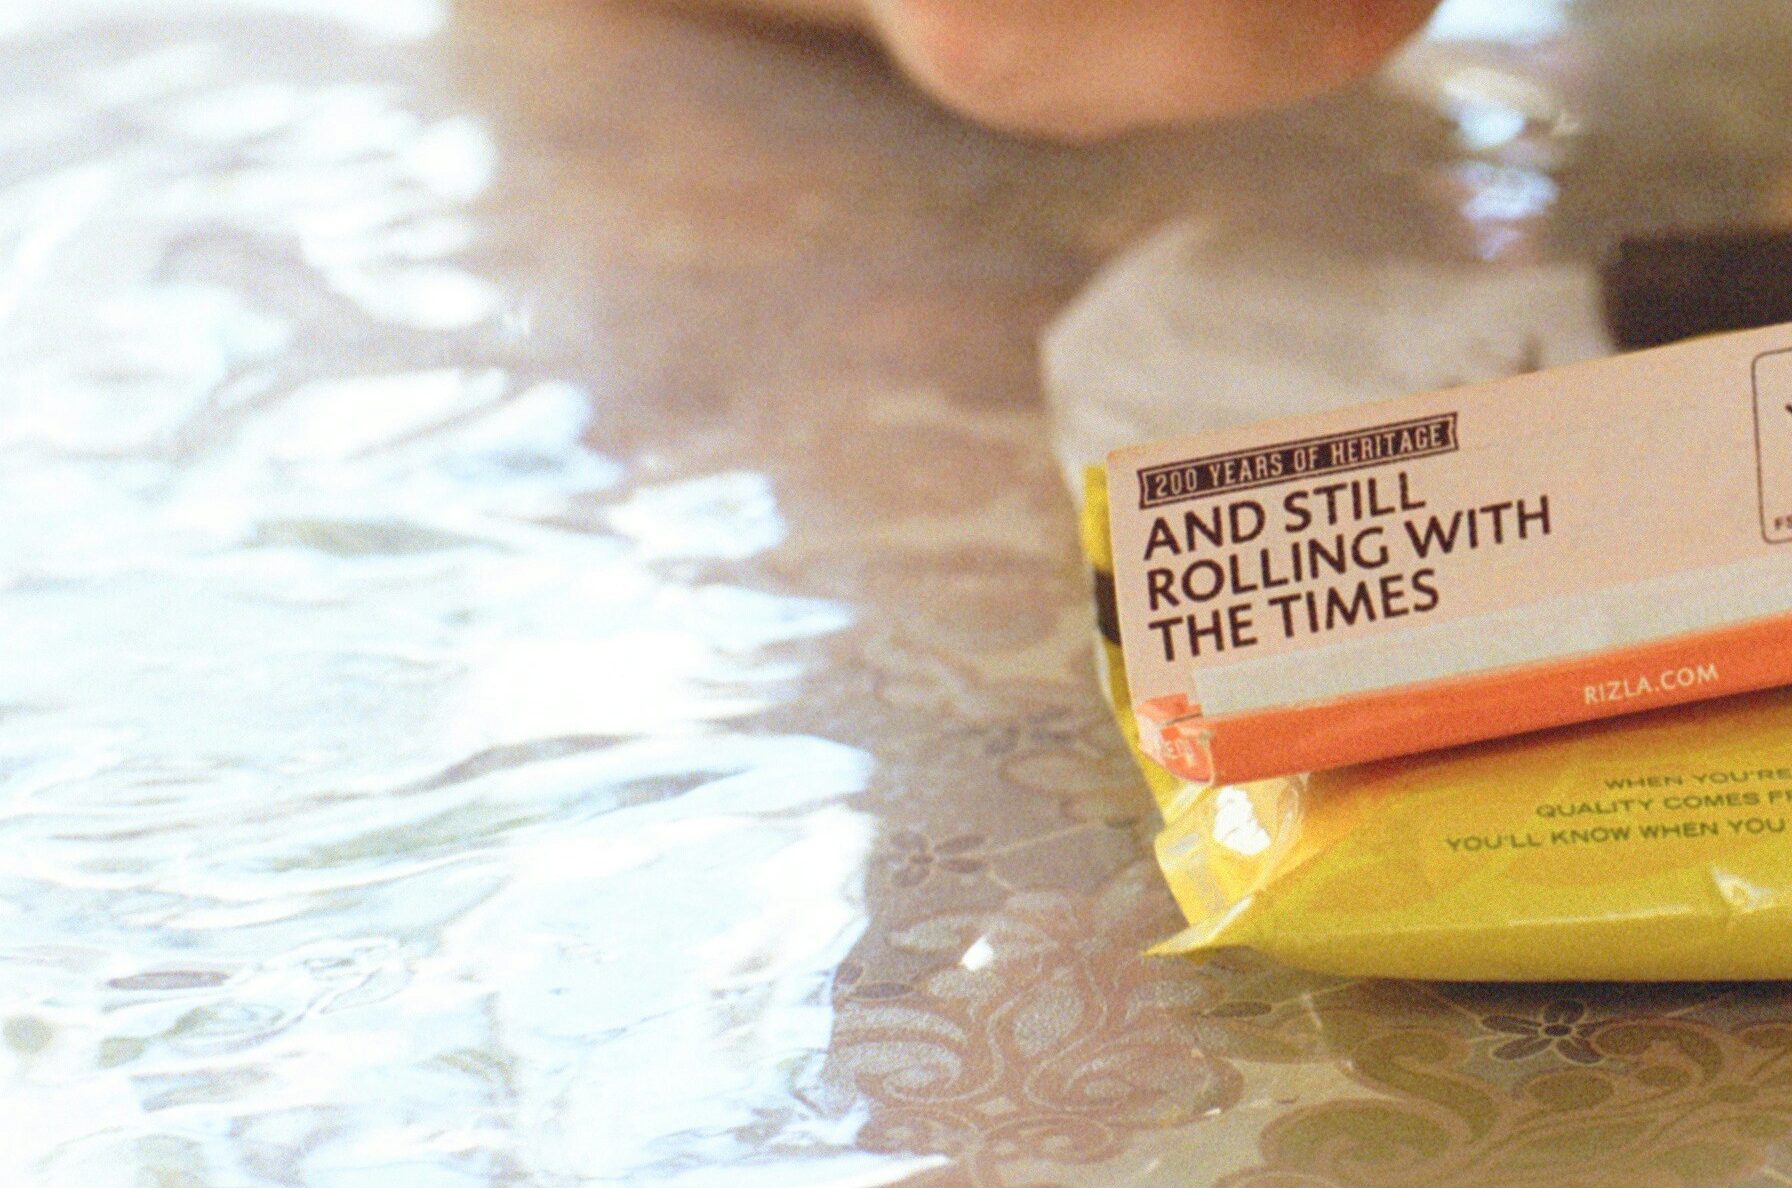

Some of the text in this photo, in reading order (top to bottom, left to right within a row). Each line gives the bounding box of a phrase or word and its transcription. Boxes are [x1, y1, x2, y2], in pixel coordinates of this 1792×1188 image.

[1155, 423, 1441, 498] 200 YEARS OF HERITAGE
[1143, 471, 1426, 561] AND STILL
[1147, 495, 1551, 611] ROLLING WITH
[1148, 568, 1440, 662] THE TIMES
[1584, 662, 1720, 705] RIZLA.COM
[1536, 798, 1653, 818] QUALITY
[1663, 791, 1760, 810] COMES
[1605, 775, 1684, 790] WHEN
[1445, 832, 1543, 853] YOU'LL
[1550, 825, 1631, 846] KNOW
[1639, 821, 1720, 841] WHEN
[1727, 816, 1786, 834] YOU
